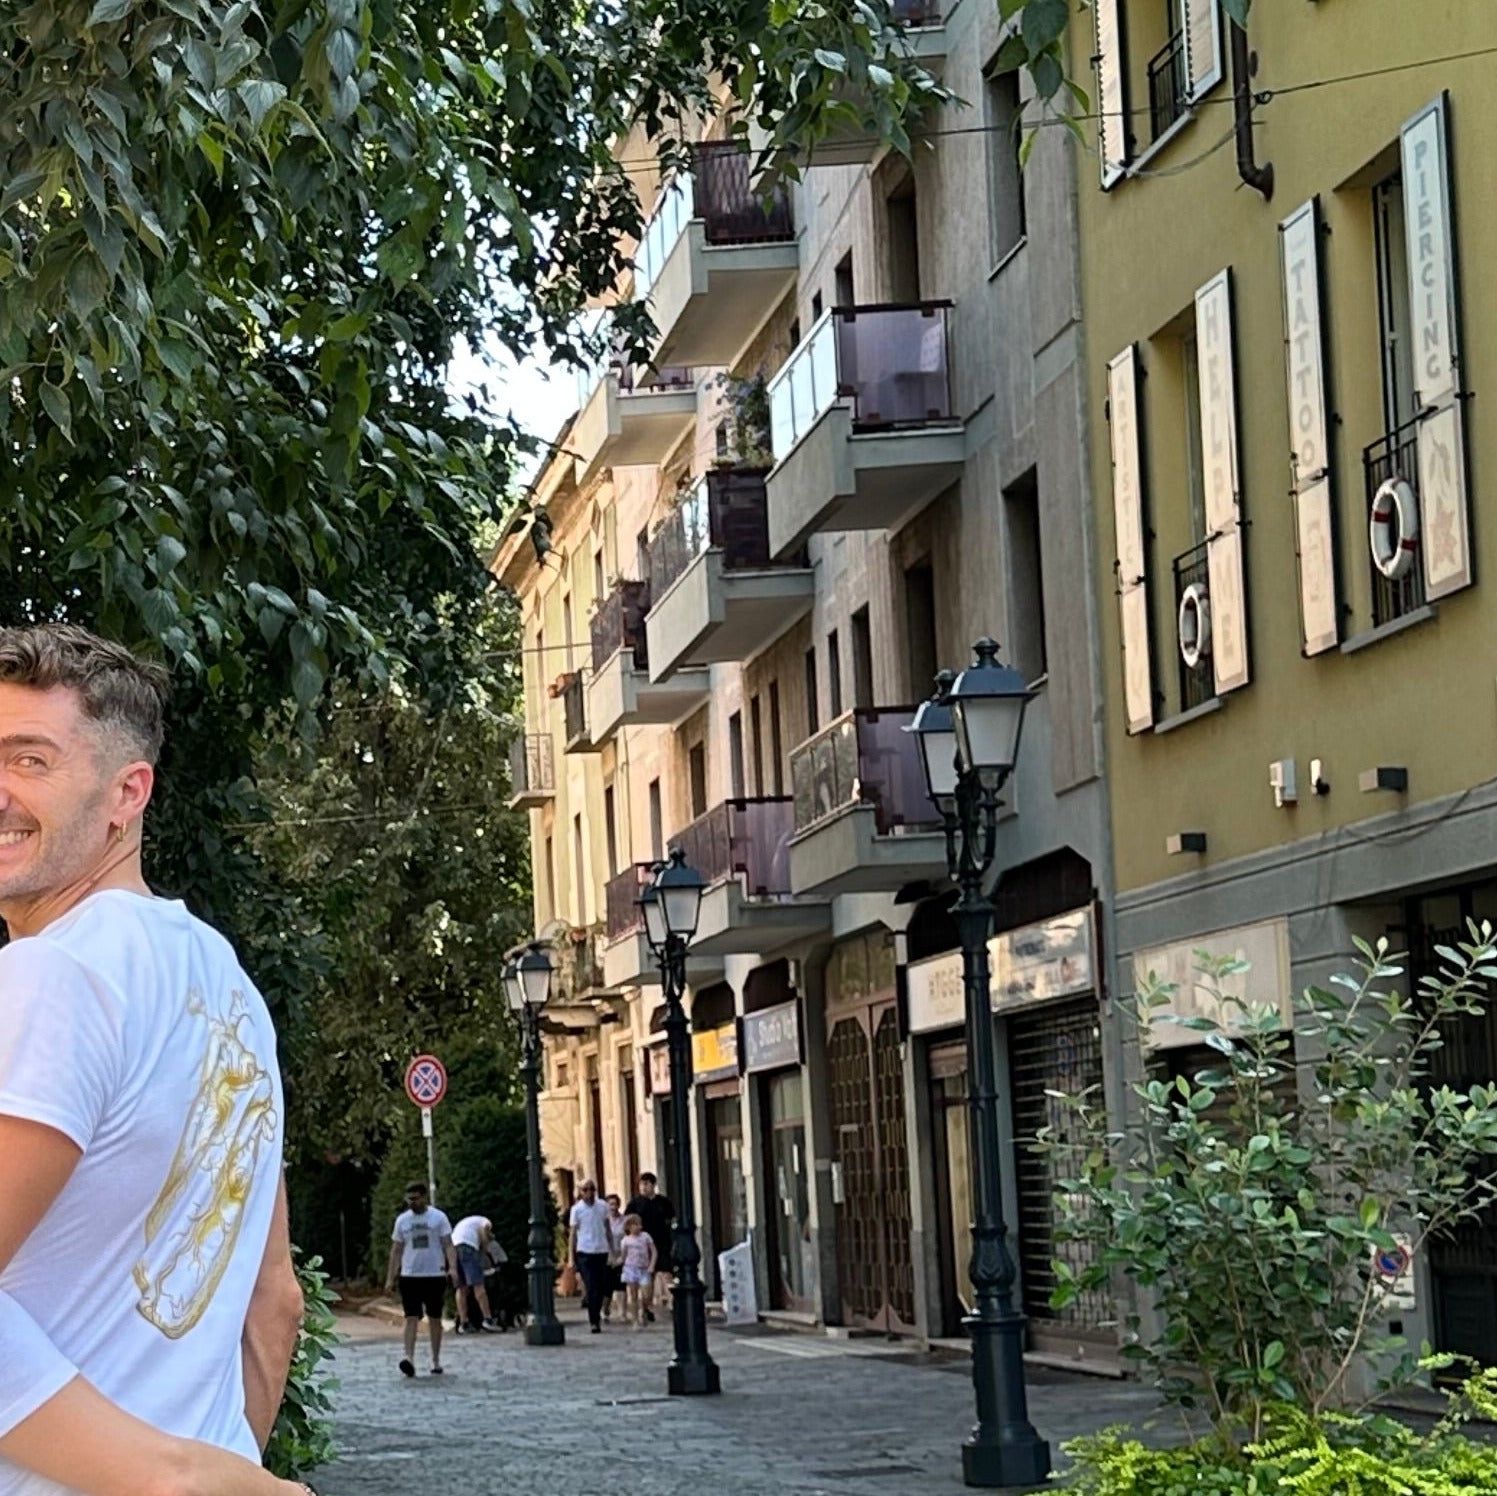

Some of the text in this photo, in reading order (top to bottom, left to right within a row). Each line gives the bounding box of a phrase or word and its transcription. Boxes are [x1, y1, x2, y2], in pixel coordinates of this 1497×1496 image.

[1290, 256, 1316, 468] TATTOO
[1413, 139, 1442, 380] PIERCING
[1117, 375, 1134, 565] ARTISTIC
